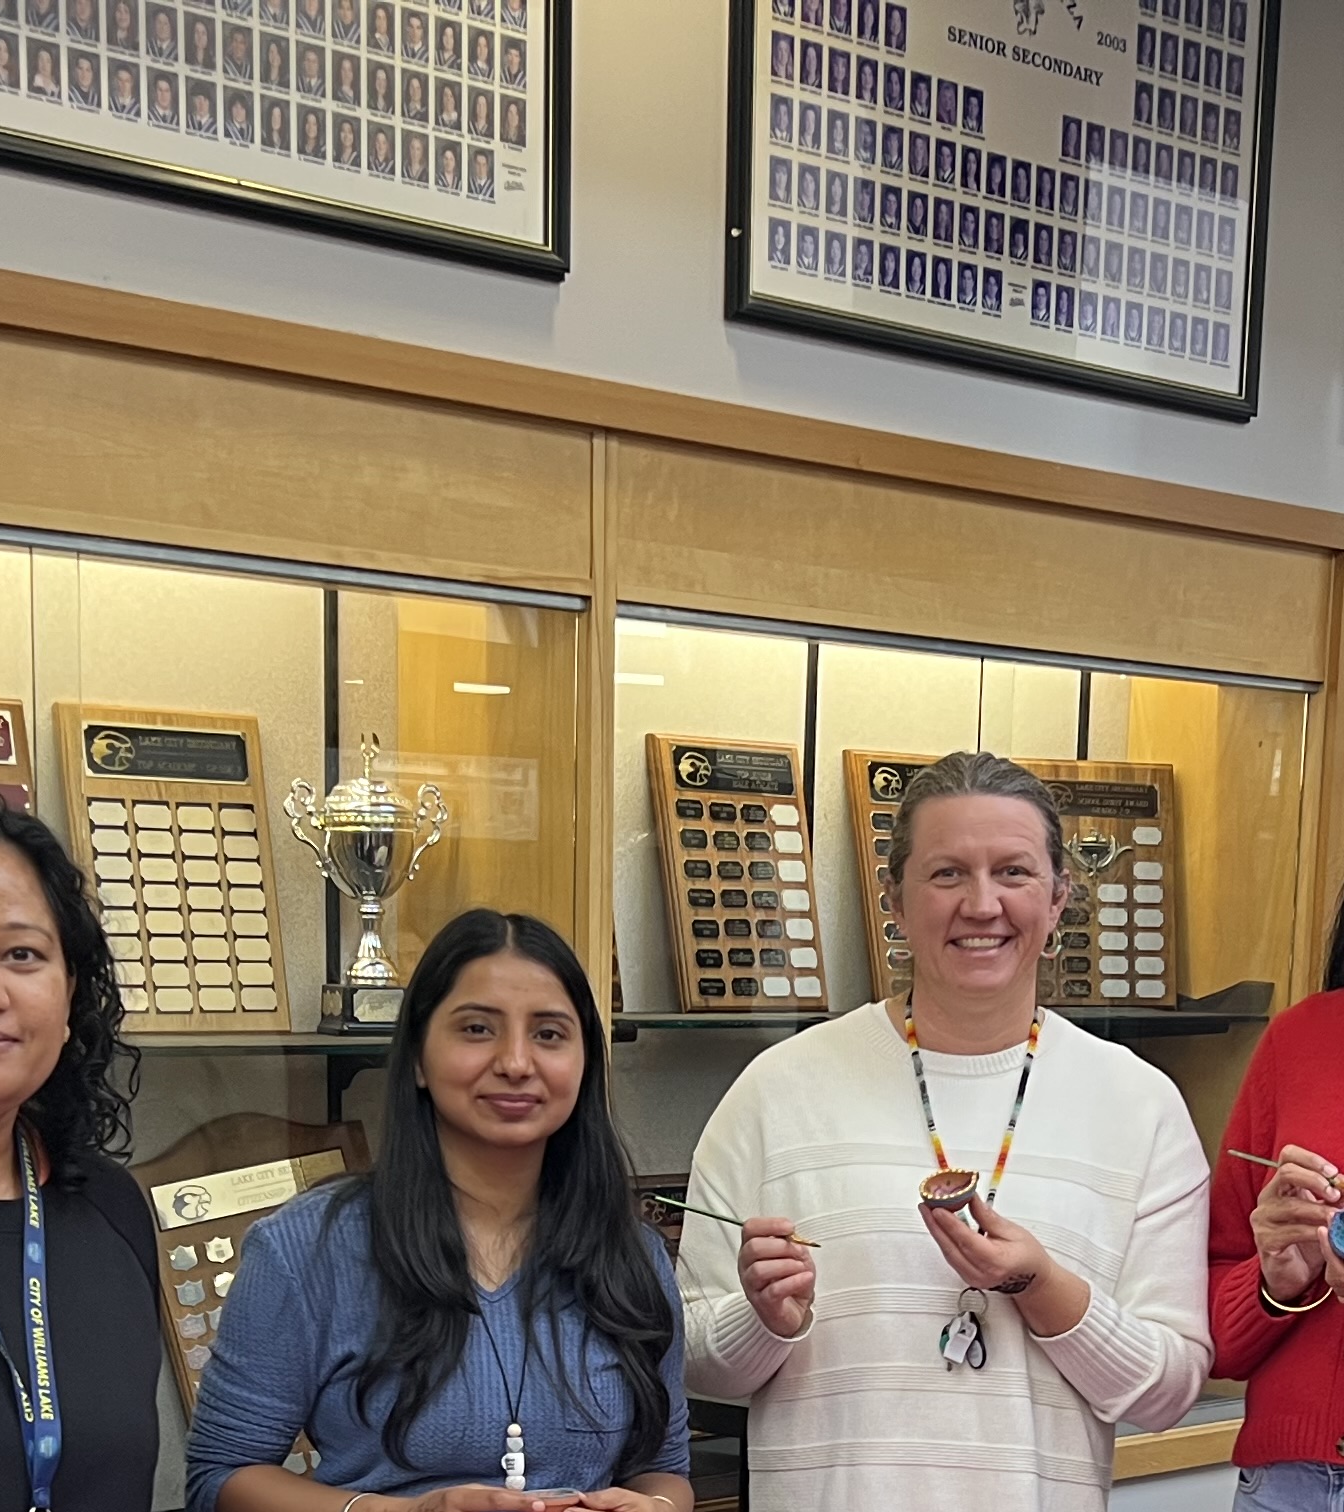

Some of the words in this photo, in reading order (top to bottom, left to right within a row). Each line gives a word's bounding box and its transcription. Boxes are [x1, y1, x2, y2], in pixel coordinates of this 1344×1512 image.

[947, 25, 1007, 58] SENIOR
[1012, 45, 1103, 87] SECONDARY
[1096, 31, 1127, 53] 2003
[231, 1173, 254, 1186] LAKE
[256, 1169, 275, 1181] CITY
[29, 1194, 40, 1229] LAKE
[29, 1277, 42, 1307] CITY
[30, 1307, 44, 1326] OF
[32, 1327, 51, 1388] WILLIAMS
[38, 1388, 55, 1421] LAKE
